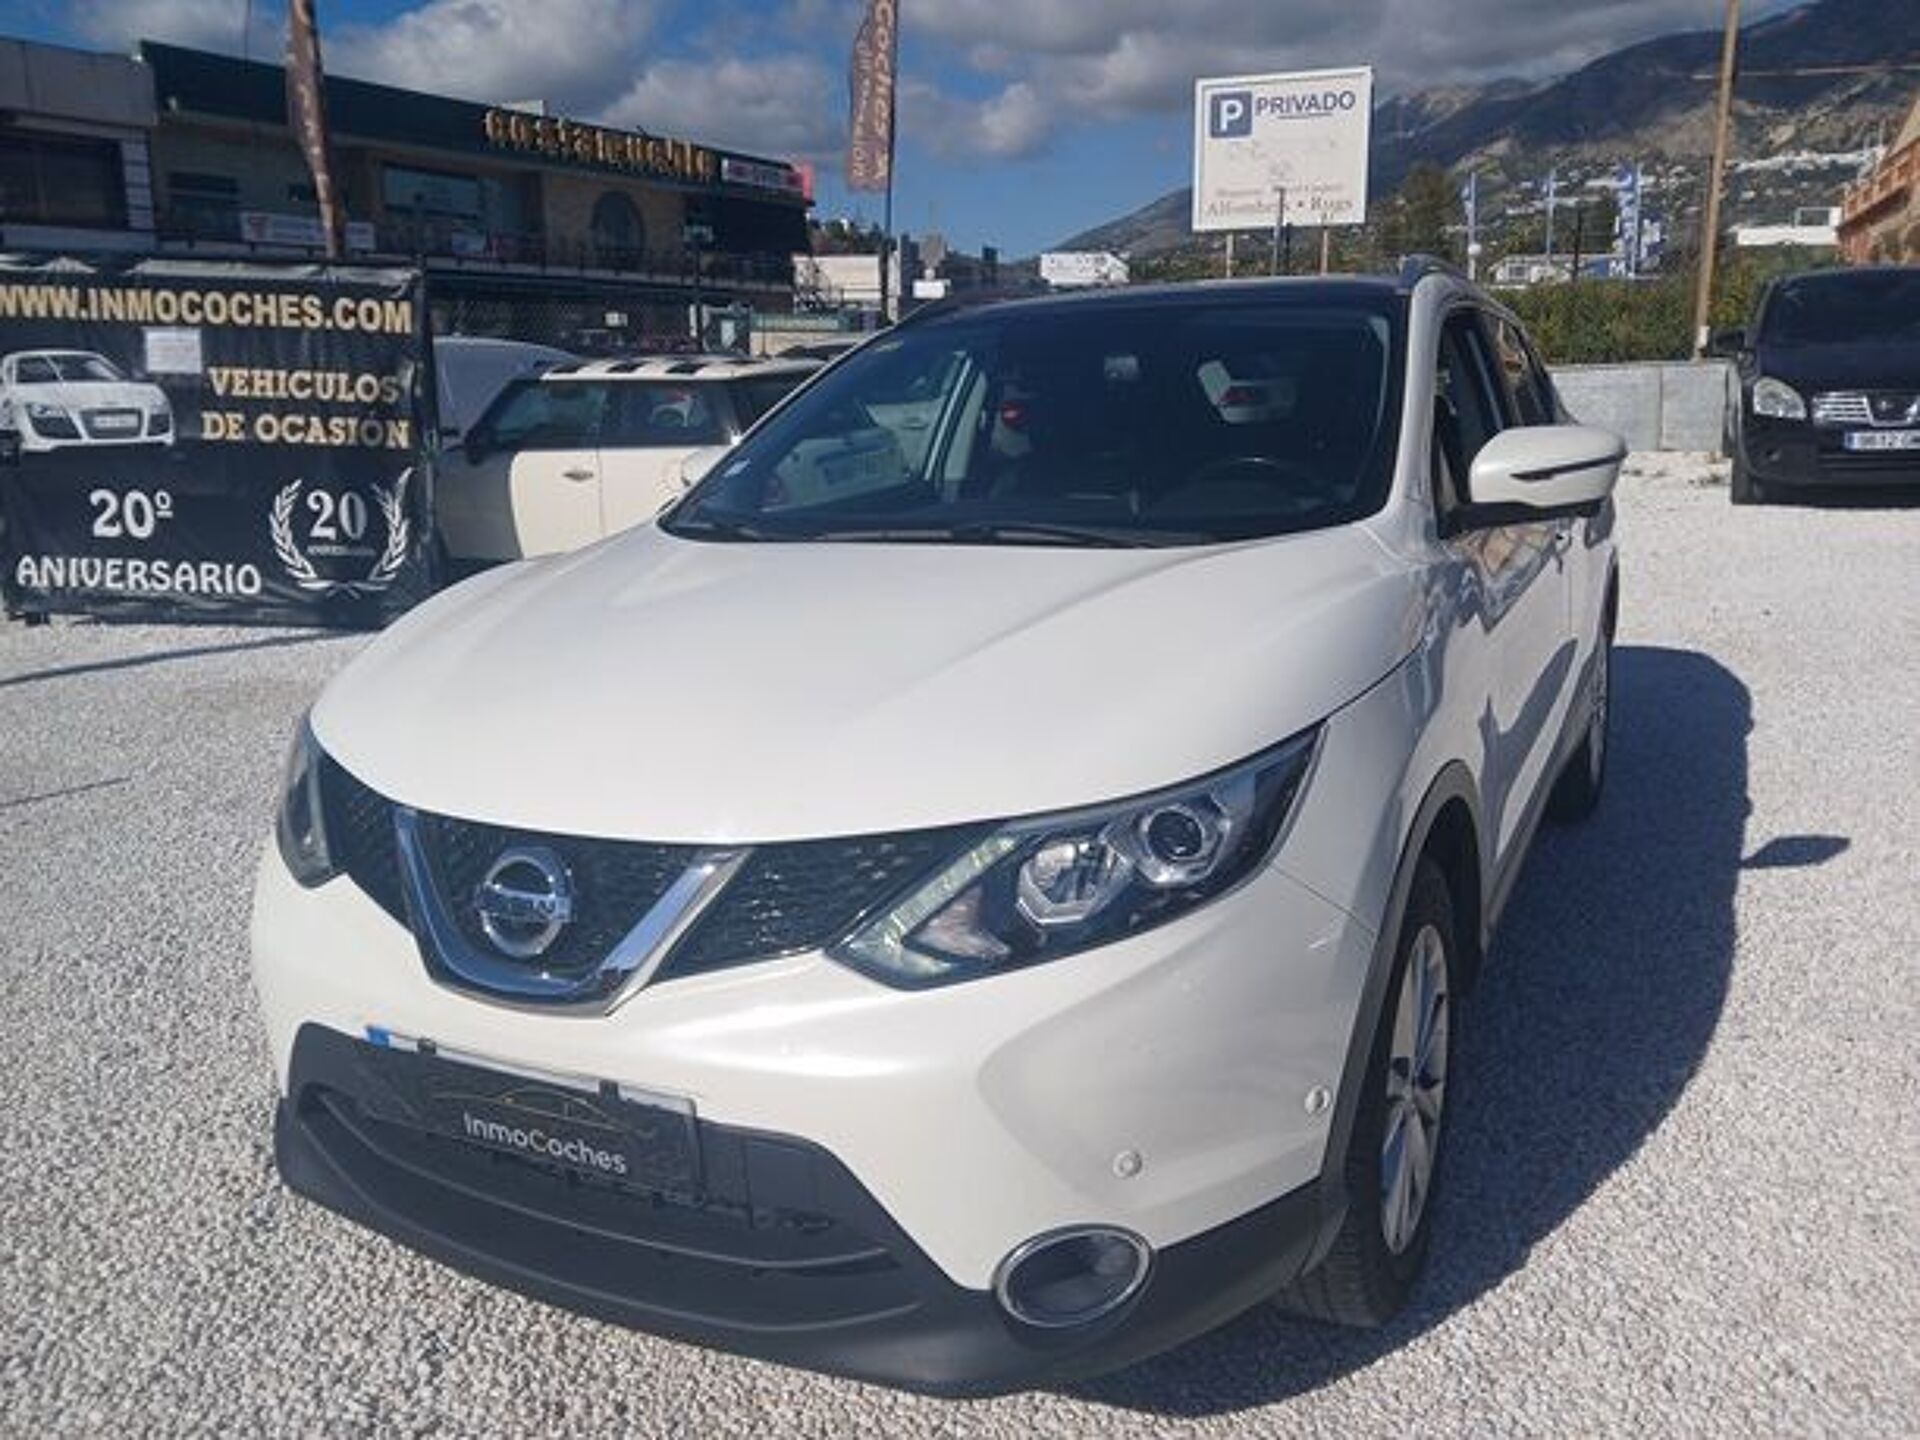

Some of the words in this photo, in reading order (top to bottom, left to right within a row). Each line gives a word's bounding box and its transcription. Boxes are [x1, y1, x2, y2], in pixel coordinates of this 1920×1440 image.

[1219, 99, 1244, 131] P
[1256, 91, 1356, 115] PRIVADO
[208, 366, 400, 404] VEHICULOS
[201, 411, 245, 441] DE
[306, 490, 368, 541] 20
[16, 555, 262, 595] ANIVERSARIO
[463, 1112, 627, 1174] InmoCoches
